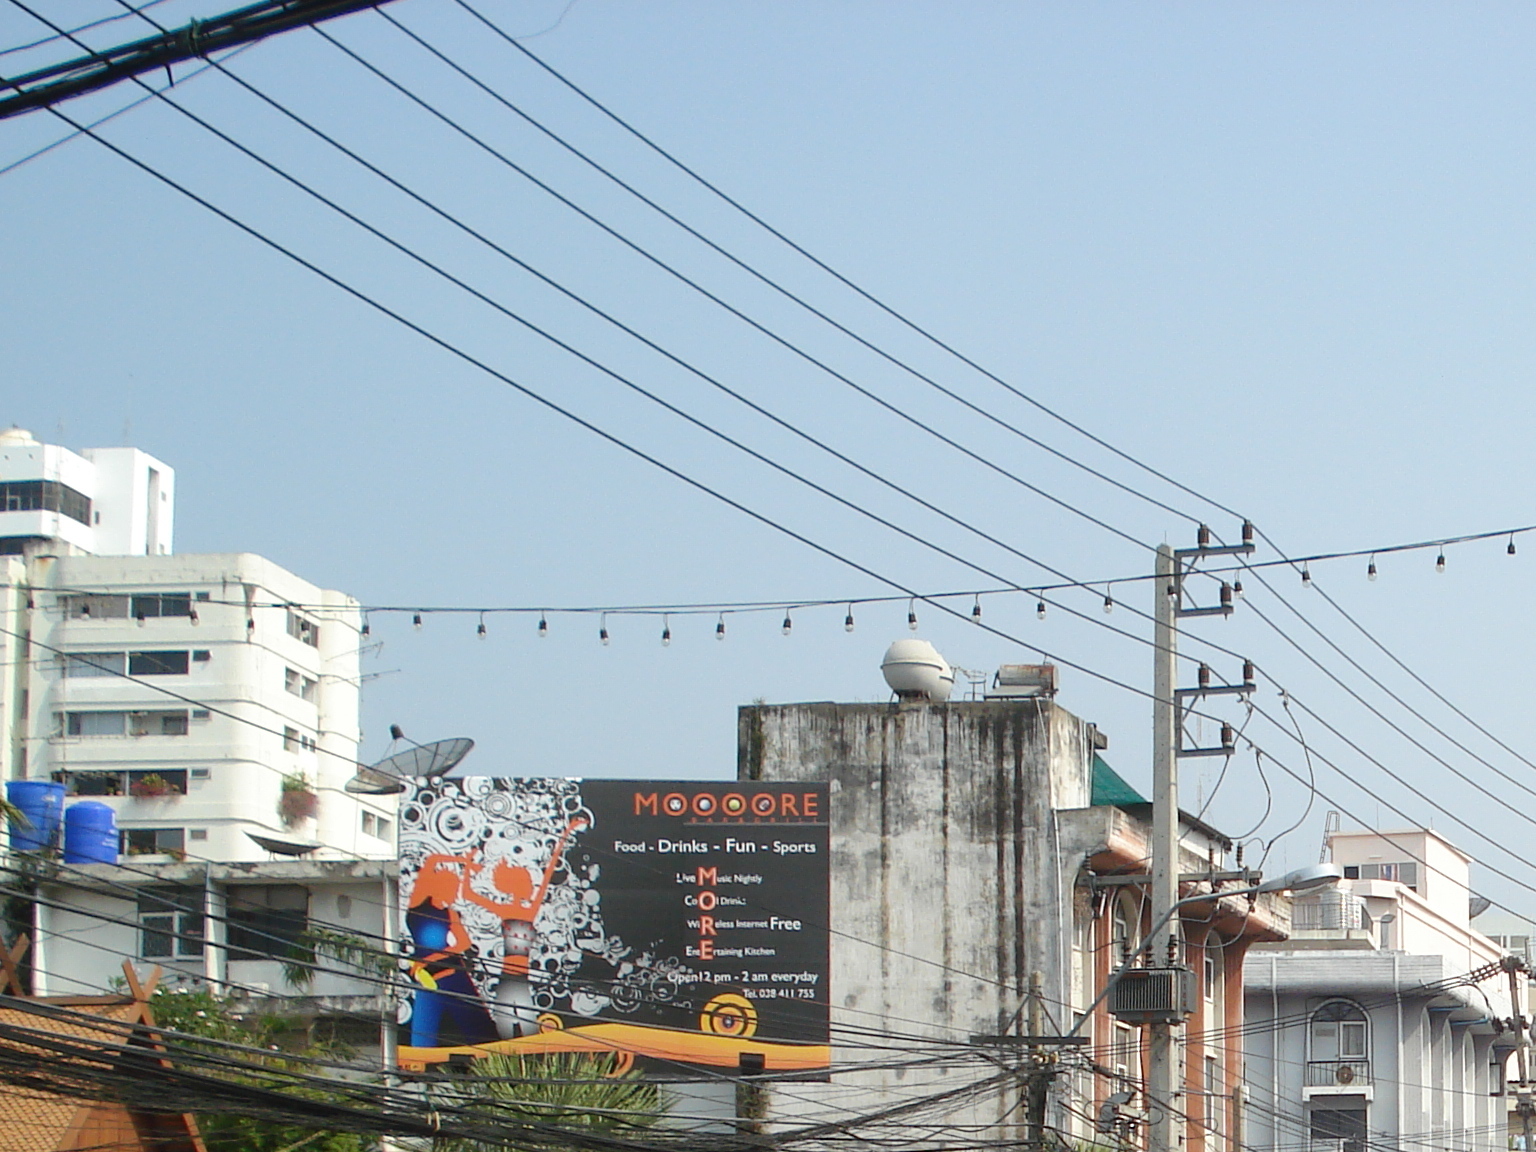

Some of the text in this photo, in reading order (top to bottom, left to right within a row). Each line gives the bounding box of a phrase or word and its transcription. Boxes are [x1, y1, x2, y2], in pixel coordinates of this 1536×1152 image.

[614, 841, 646, 853] Food
[658, 839, 708, 853] Drinks
[726, 838, 756, 853] Fun
[773, 841, 817, 856] Sports
[676, 873, 696, 884] Live
[734, 874, 763, 884] Nightly
[736, 920, 769, 929] Internet
[770, 916, 802, 931] Free
[744, 946, 776, 956] Kitchen
[713, 974, 732, 984] pm
[742, 971, 750, 982] 2
[751, 973, 769, 982] am
[771, 971, 819, 984] everyday
